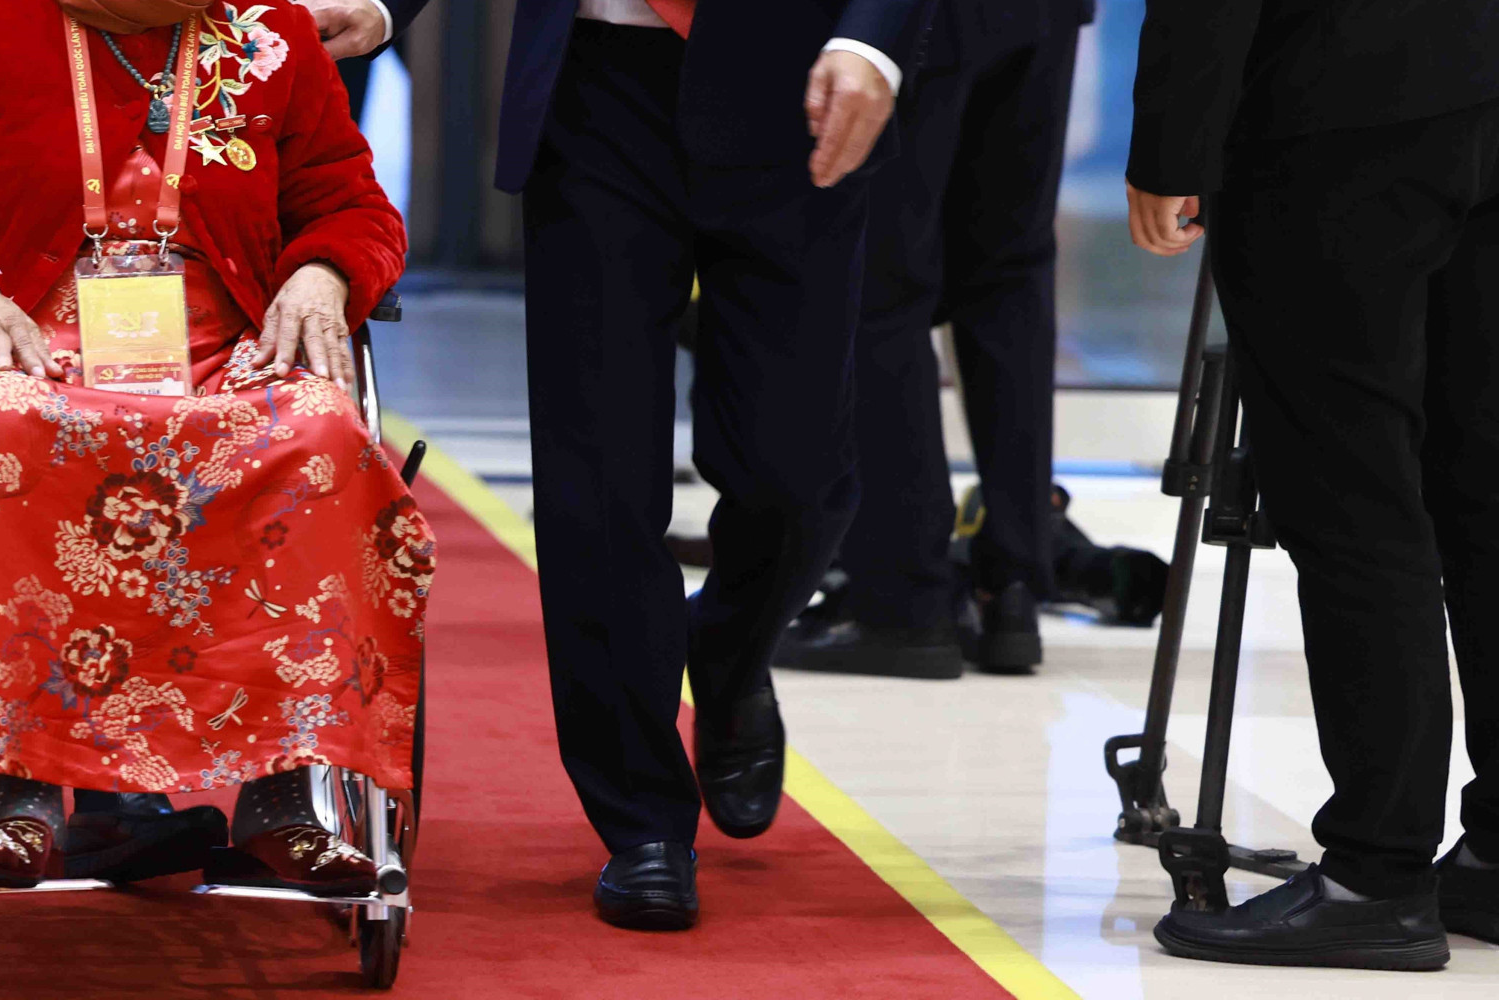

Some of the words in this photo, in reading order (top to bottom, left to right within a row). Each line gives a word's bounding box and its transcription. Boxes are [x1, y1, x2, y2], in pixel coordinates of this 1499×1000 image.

[71, 32, 82, 48] LẦN
[186, 33, 195, 48] LẦN
[73, 48, 85, 70] QUỐC
[183, 49, 194, 69] QUỐC
[77, 71, 87, 91] TOÀN
[181, 70, 192, 89] TOÀN
[79, 92, 90, 109] BIỂU
[179, 90, 189, 107] BIỂU
[82, 110, 92, 124] ĐẠI
[178, 107, 189, 121] ĐẠI
[83, 125, 94, 139] HỘI
[176, 121, 186, 136] HỘI
[85, 140, 96, 154] ĐẠI
[174, 136, 184, 150] ĐẠI
